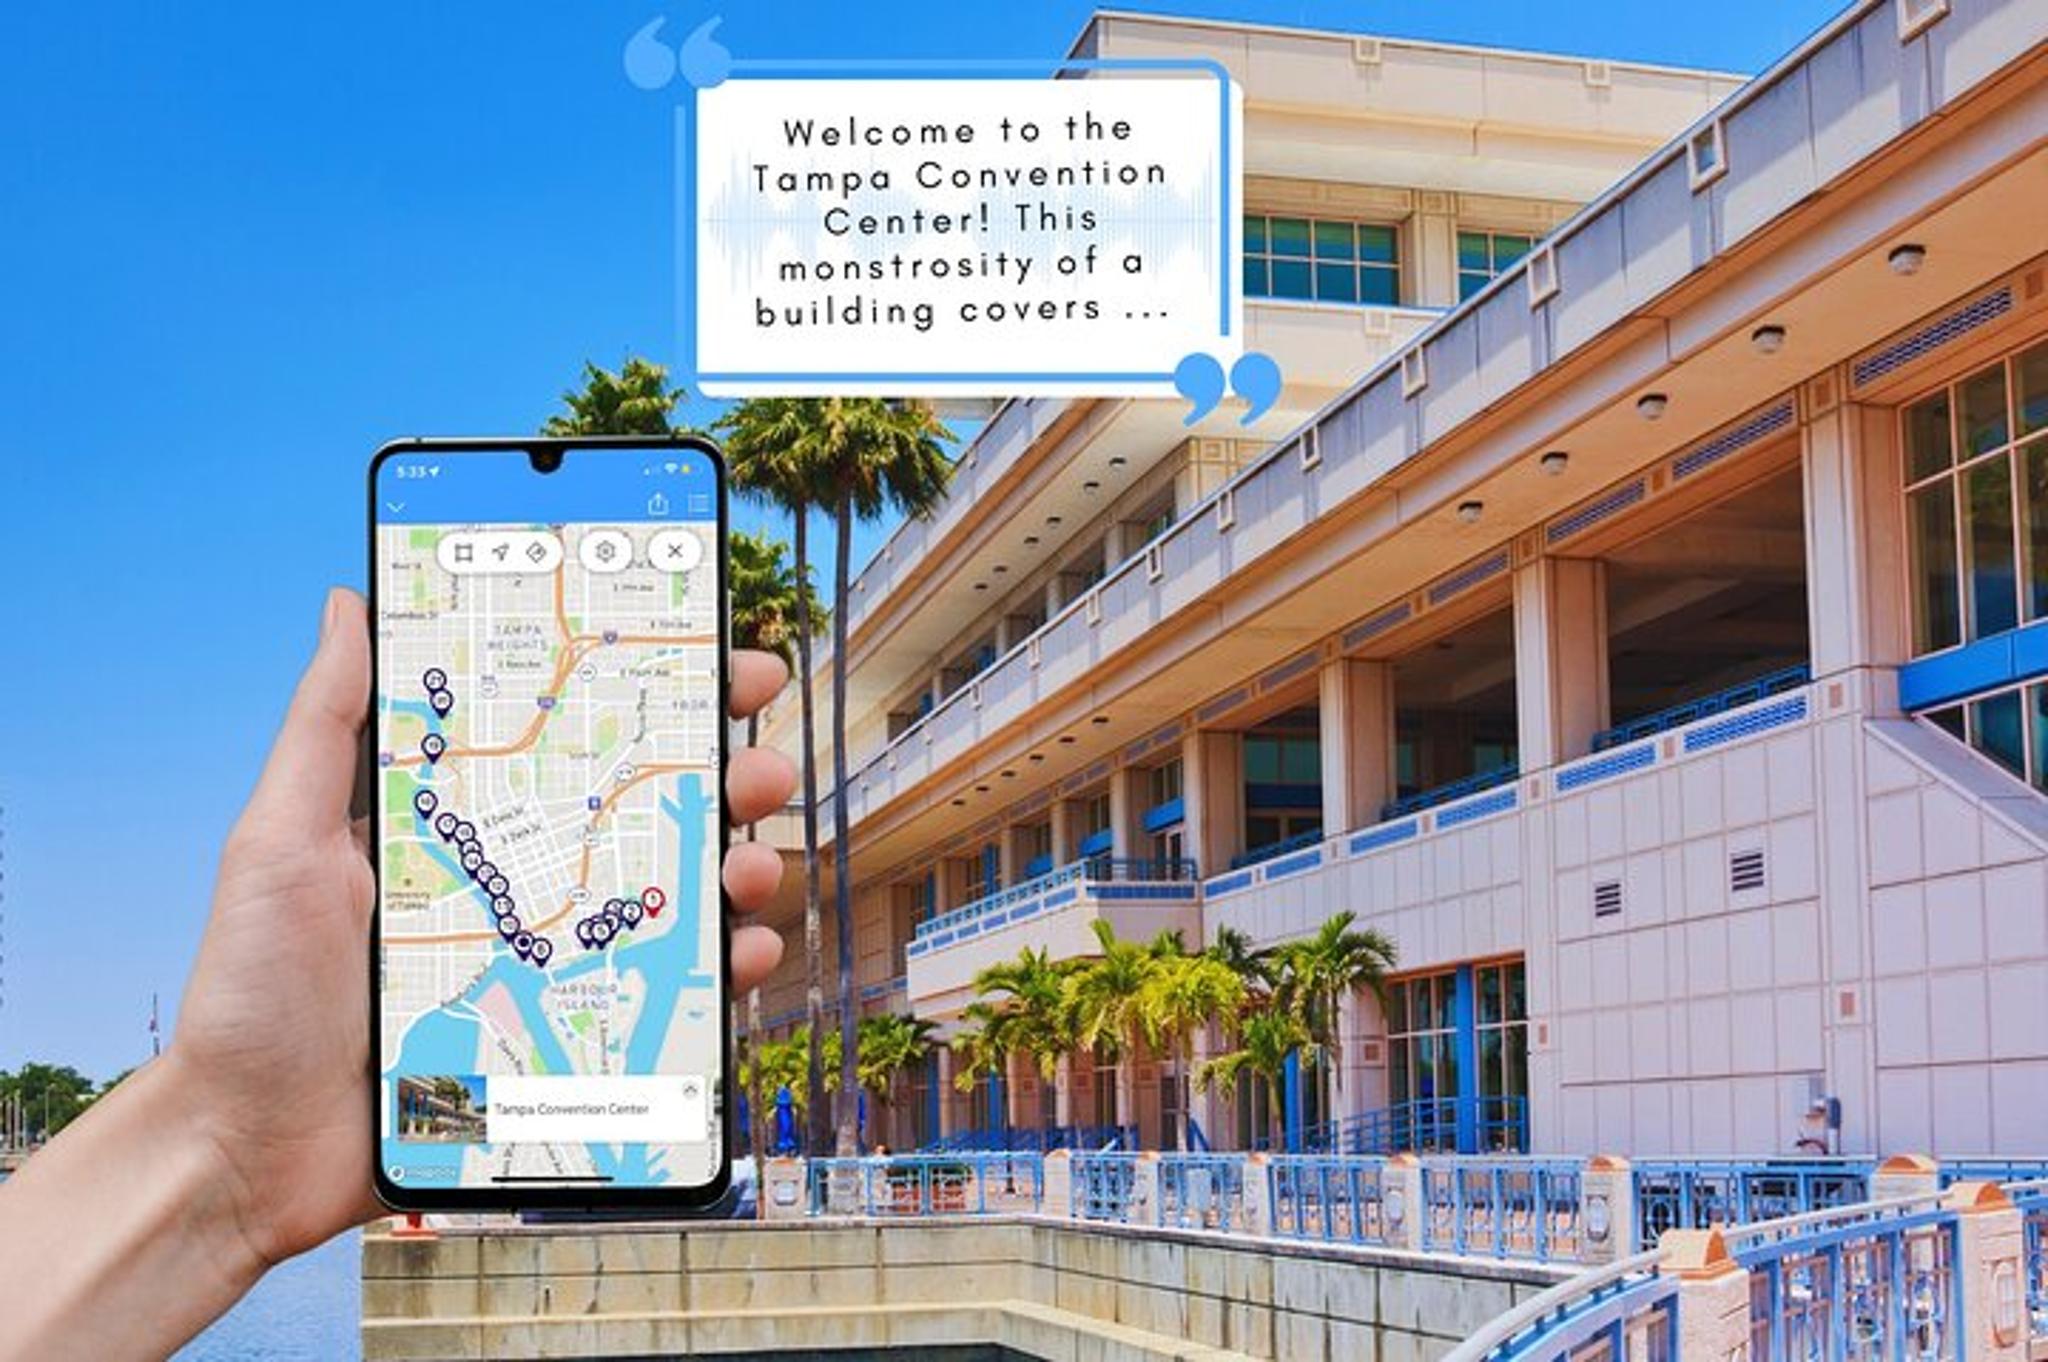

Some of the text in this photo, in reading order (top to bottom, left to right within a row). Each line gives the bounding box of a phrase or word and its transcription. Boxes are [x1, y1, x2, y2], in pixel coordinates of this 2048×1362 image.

[494, 1102, 649, 1117] Tampa Convention Center
